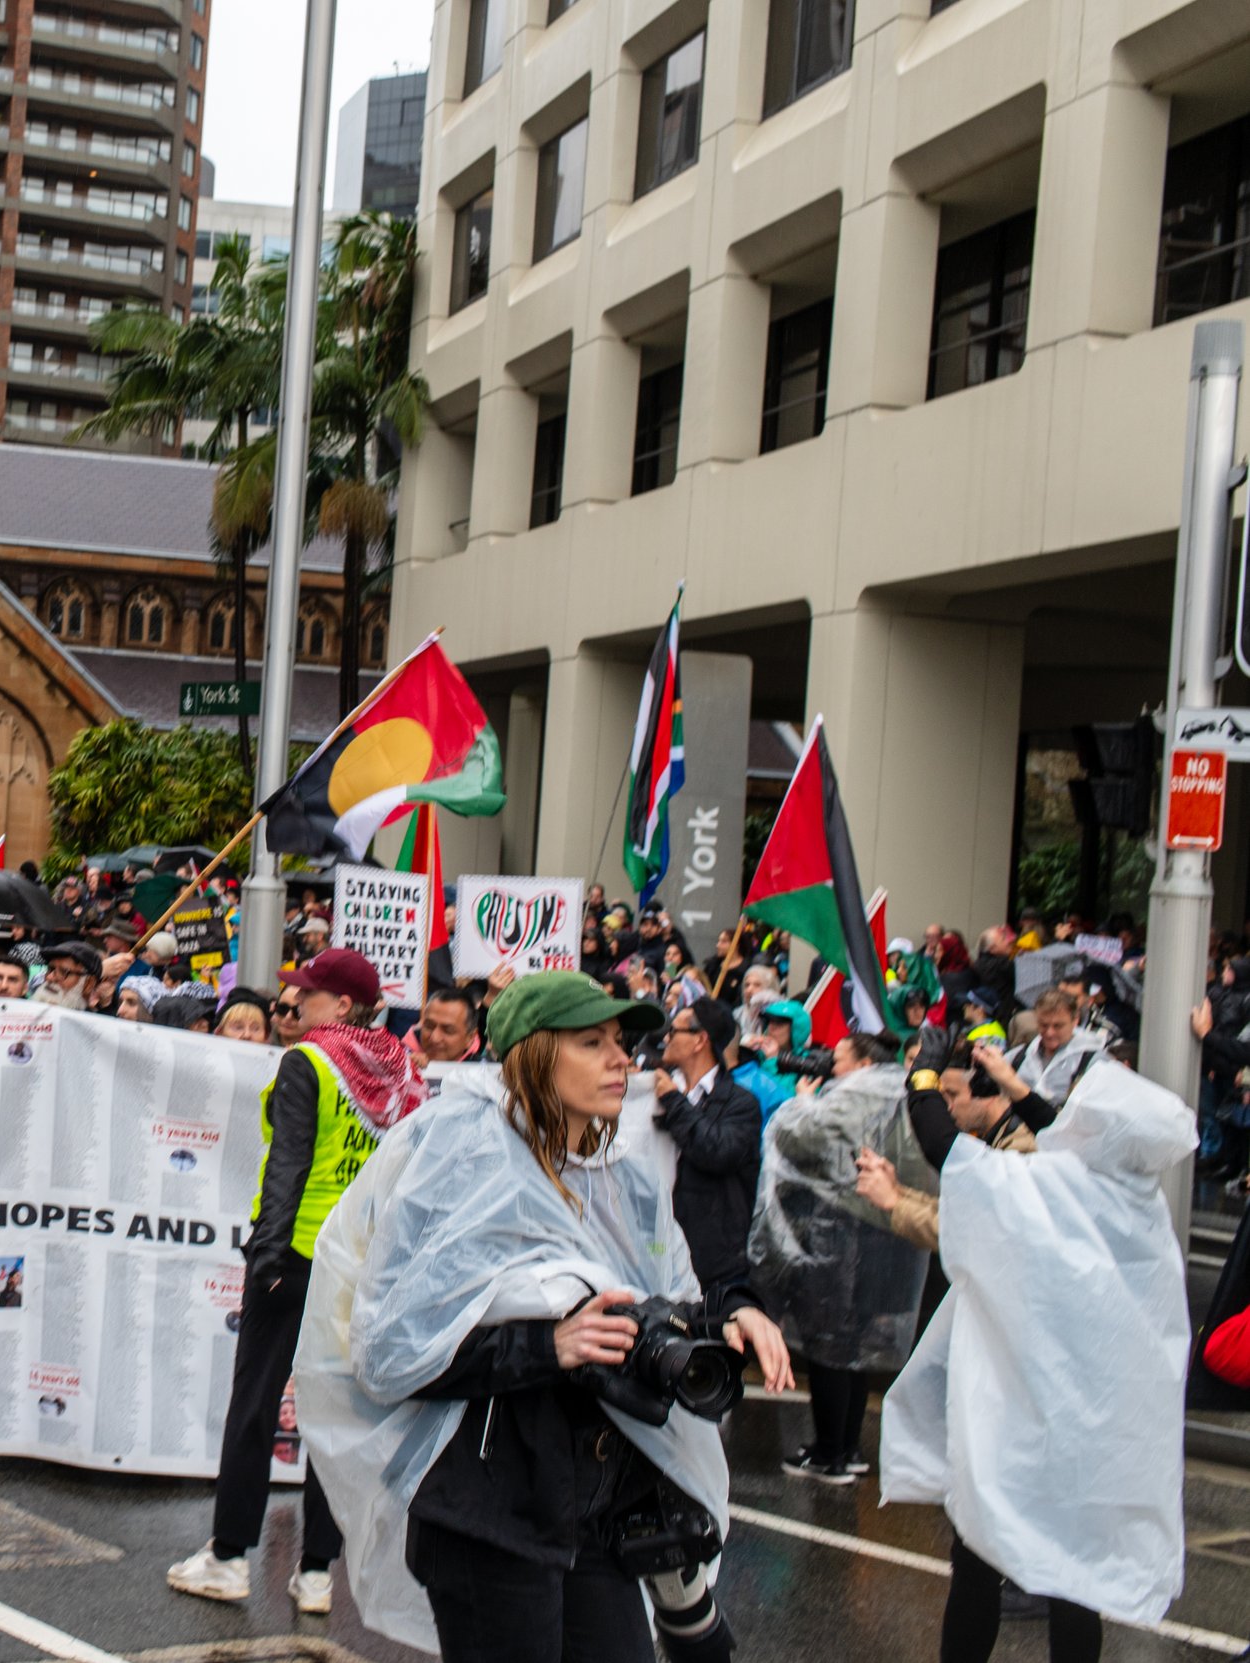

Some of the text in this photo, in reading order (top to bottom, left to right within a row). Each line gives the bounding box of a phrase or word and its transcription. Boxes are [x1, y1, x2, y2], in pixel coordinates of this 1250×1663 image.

[200, 684, 241, 704] York St
[1186, 757, 1211, 778] NO
[1170, 775, 1223, 795] STOPPING
[681, 805, 720, 928] 1 York
[345, 878, 420, 904] STARVING
[344, 901, 416, 924] CHILDREN
[344, 922, 418, 942] ARE NOT A
[344, 941, 417, 960] MILITARY
[544, 956, 575, 970] FREE
[167, 1128, 197, 1140] years
[201, 1131, 219, 1143] old
[126, 1214, 216, 1245] AND
